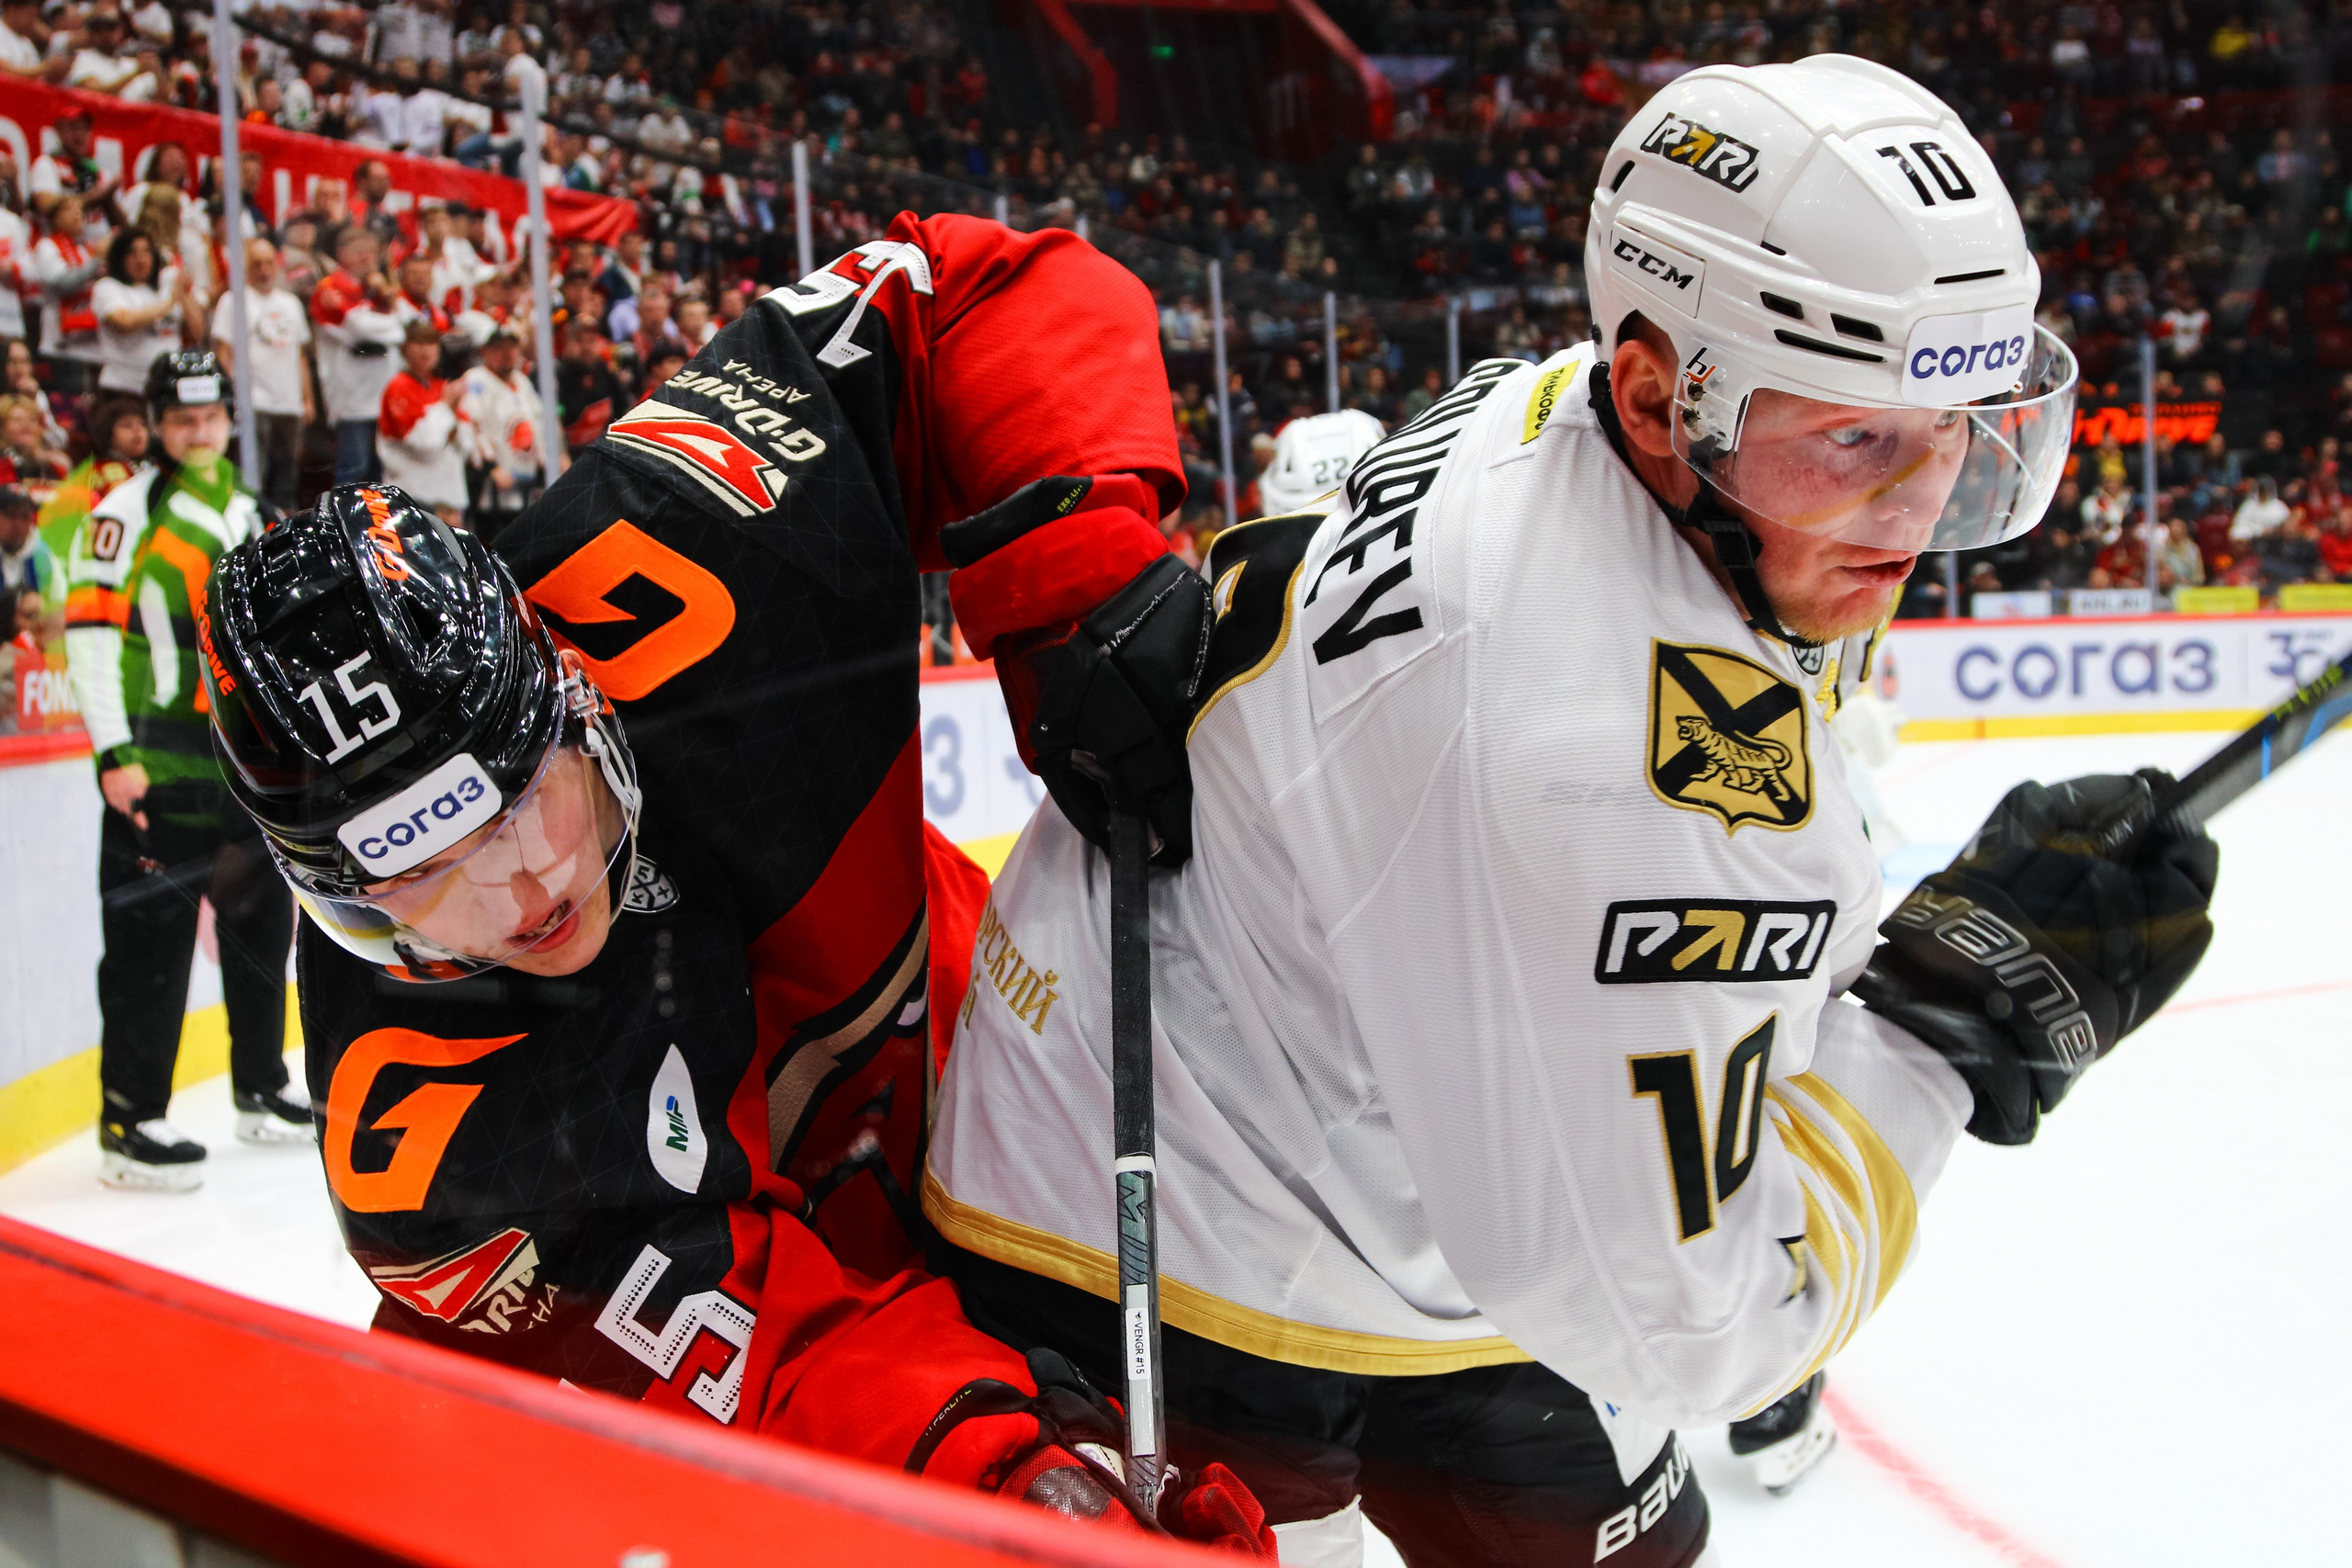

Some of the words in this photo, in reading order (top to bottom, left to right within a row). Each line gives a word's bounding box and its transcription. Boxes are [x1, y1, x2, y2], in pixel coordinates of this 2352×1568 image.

[1645, 114, 1758, 189] PARI
[1877, 141, 1976, 207] 10
[1613, 238, 1695, 290] CCM
[1910, 335, 2025, 379] согаз
[1312, 457, 1349, 485] 22
[1955, 638, 2216, 702] согаз
[299, 650, 401, 766] 15
[357, 776, 486, 860] согаз
[1604, 908, 1828, 974] PARI
[1625, 1009, 1778, 1246] 10
[1134, 1322, 1145, 1356] VENGR
[1136, 1357, 1146, 1375] #15
